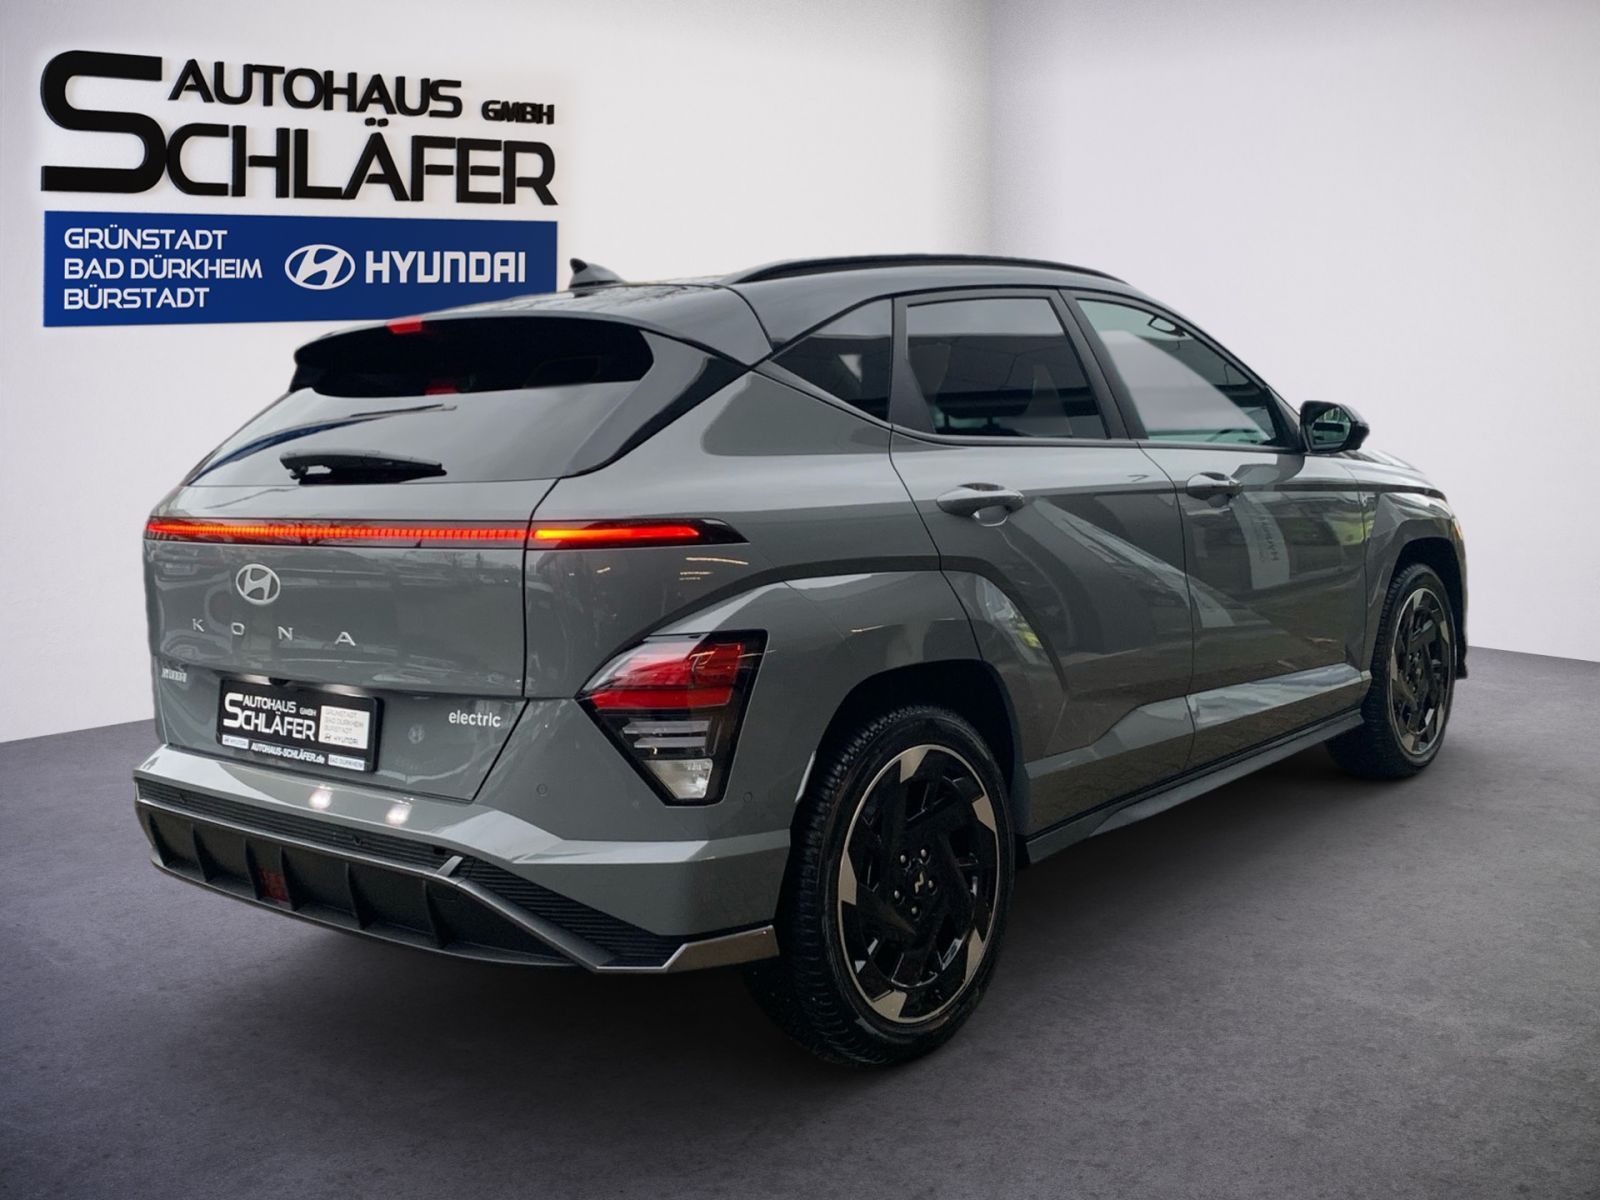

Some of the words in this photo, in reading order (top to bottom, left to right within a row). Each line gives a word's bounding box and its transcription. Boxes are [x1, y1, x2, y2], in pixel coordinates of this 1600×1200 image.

[168, 58, 463, 118] AUTOHAUS
[40, 50, 559, 206] SCHLÄFER
[63, 225, 228, 250] GRÜNSTADT
[63, 258, 125, 280] BAD
[130, 253, 263, 280] DÜRKHEIM
[365, 250, 526, 284] HYUNDAI
[63, 284, 210, 310] BÜRSTADT
[223, 692, 316, 742] SCHLÄFER
[242, 694, 297, 714] AUTOHAUS
[448, 709, 502, 728] electric
